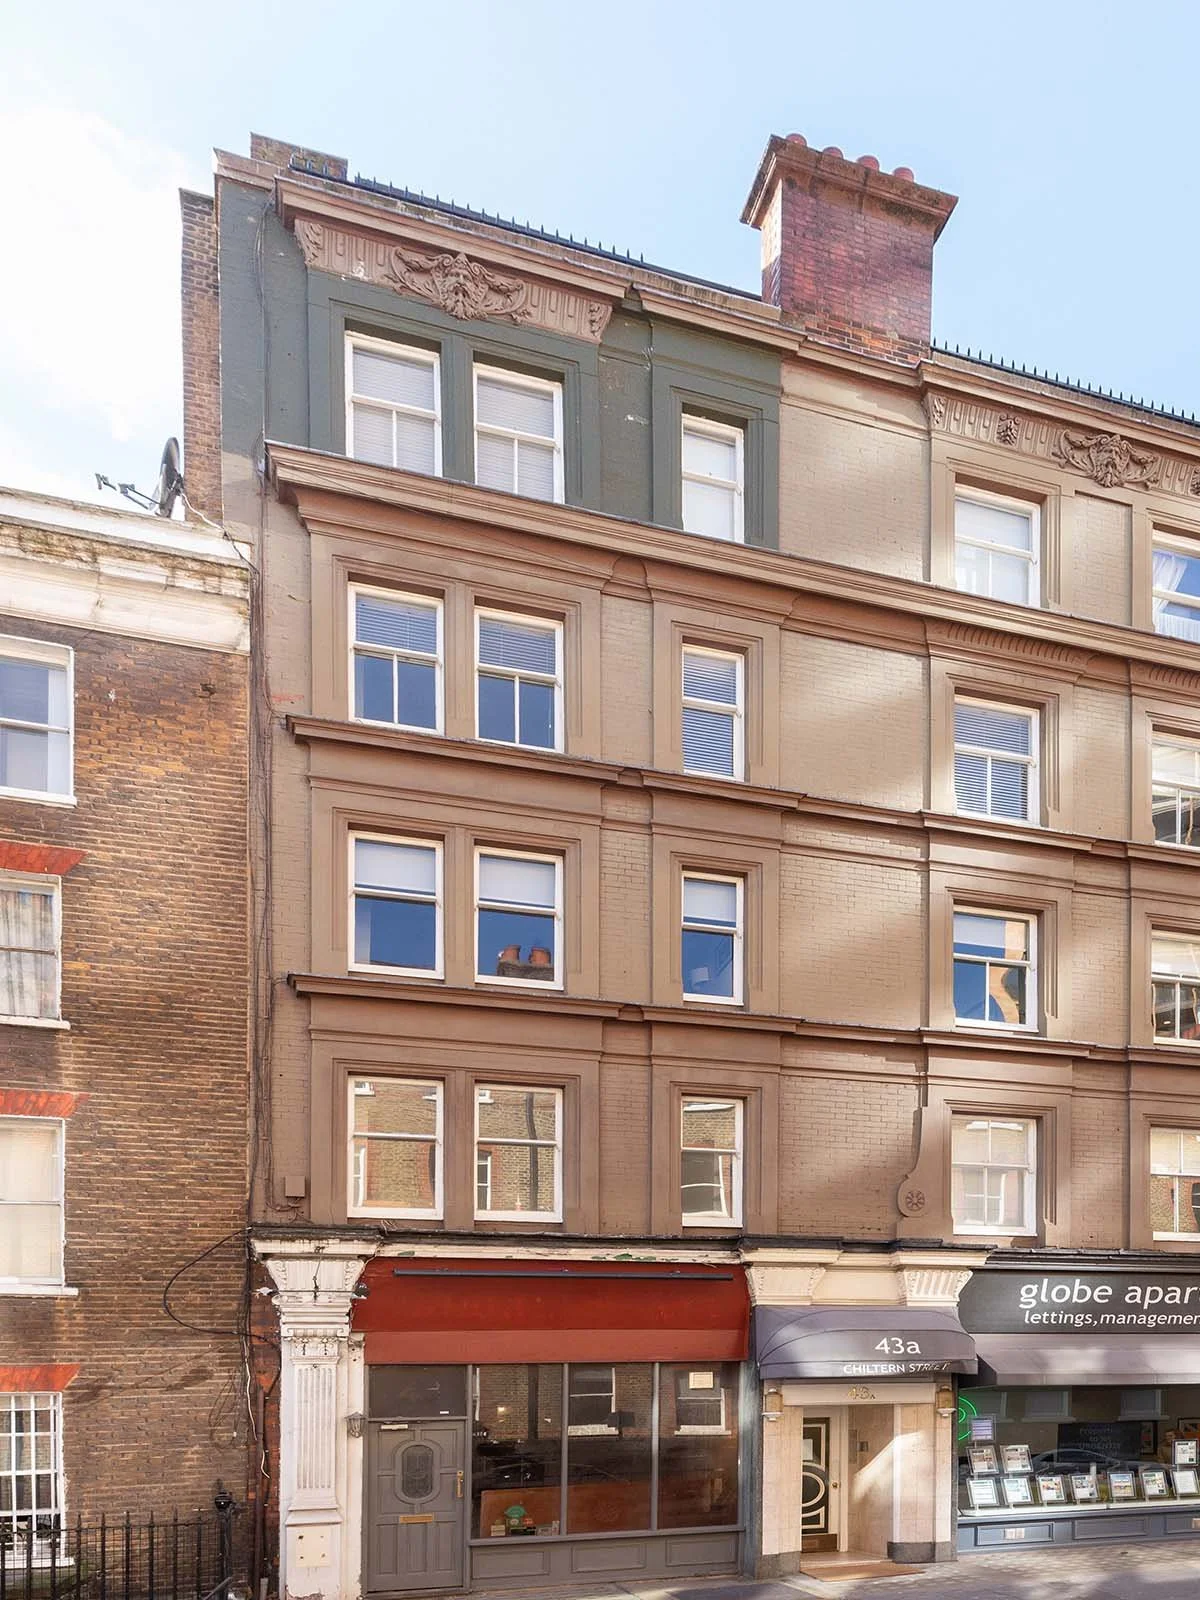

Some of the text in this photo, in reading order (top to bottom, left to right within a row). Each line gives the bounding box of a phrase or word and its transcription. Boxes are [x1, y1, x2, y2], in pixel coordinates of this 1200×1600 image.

[1018, 1278, 1113, 1309] globe
[874, 1337, 921, 1355] 43a
[843, 1361, 951, 1374] CHILTERN STREET
